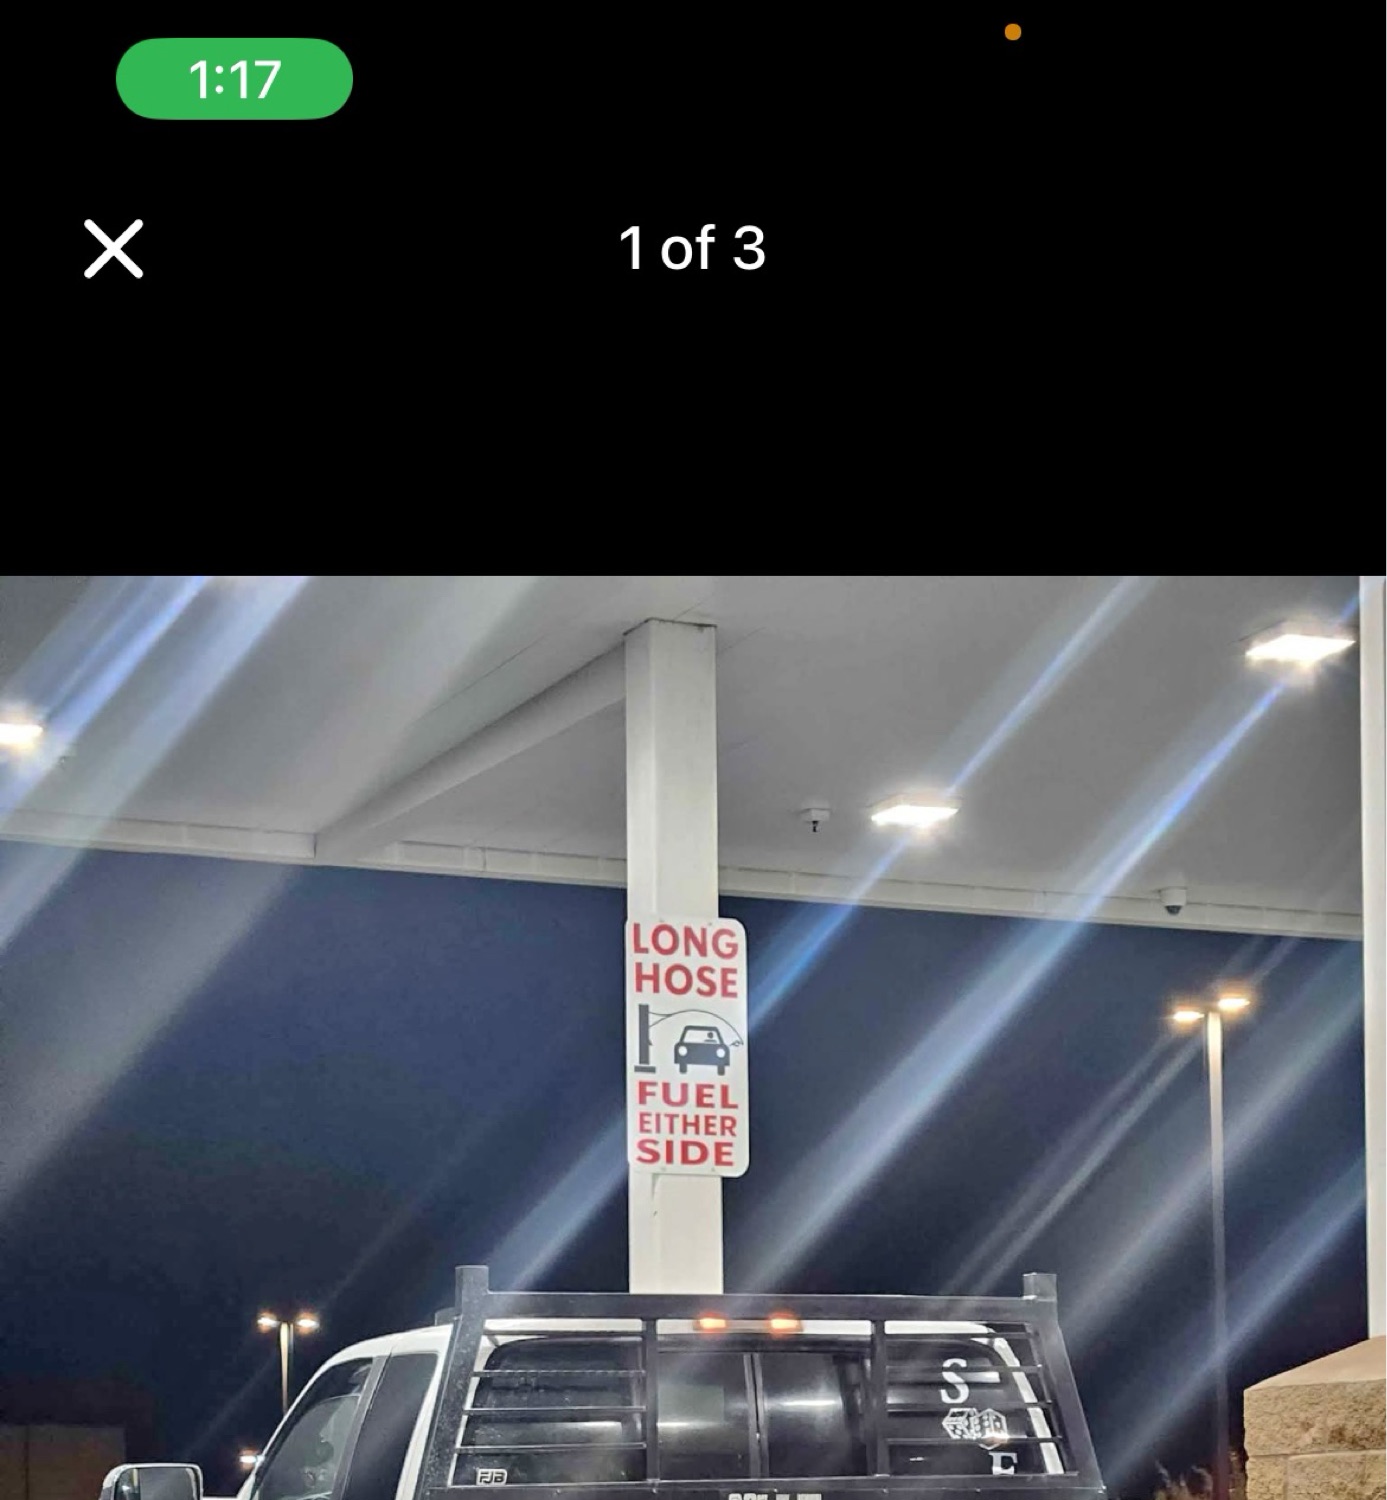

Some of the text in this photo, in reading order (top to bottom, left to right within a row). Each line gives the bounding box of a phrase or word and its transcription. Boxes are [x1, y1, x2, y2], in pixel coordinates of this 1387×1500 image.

[632, 922, 739, 960] LONG
[634, 961, 738, 998] HOSE
[637, 1080, 738, 1109] FUEL
[638, 1111, 737, 1137] EITHER
[636, 1138, 734, 1167] SIDE
